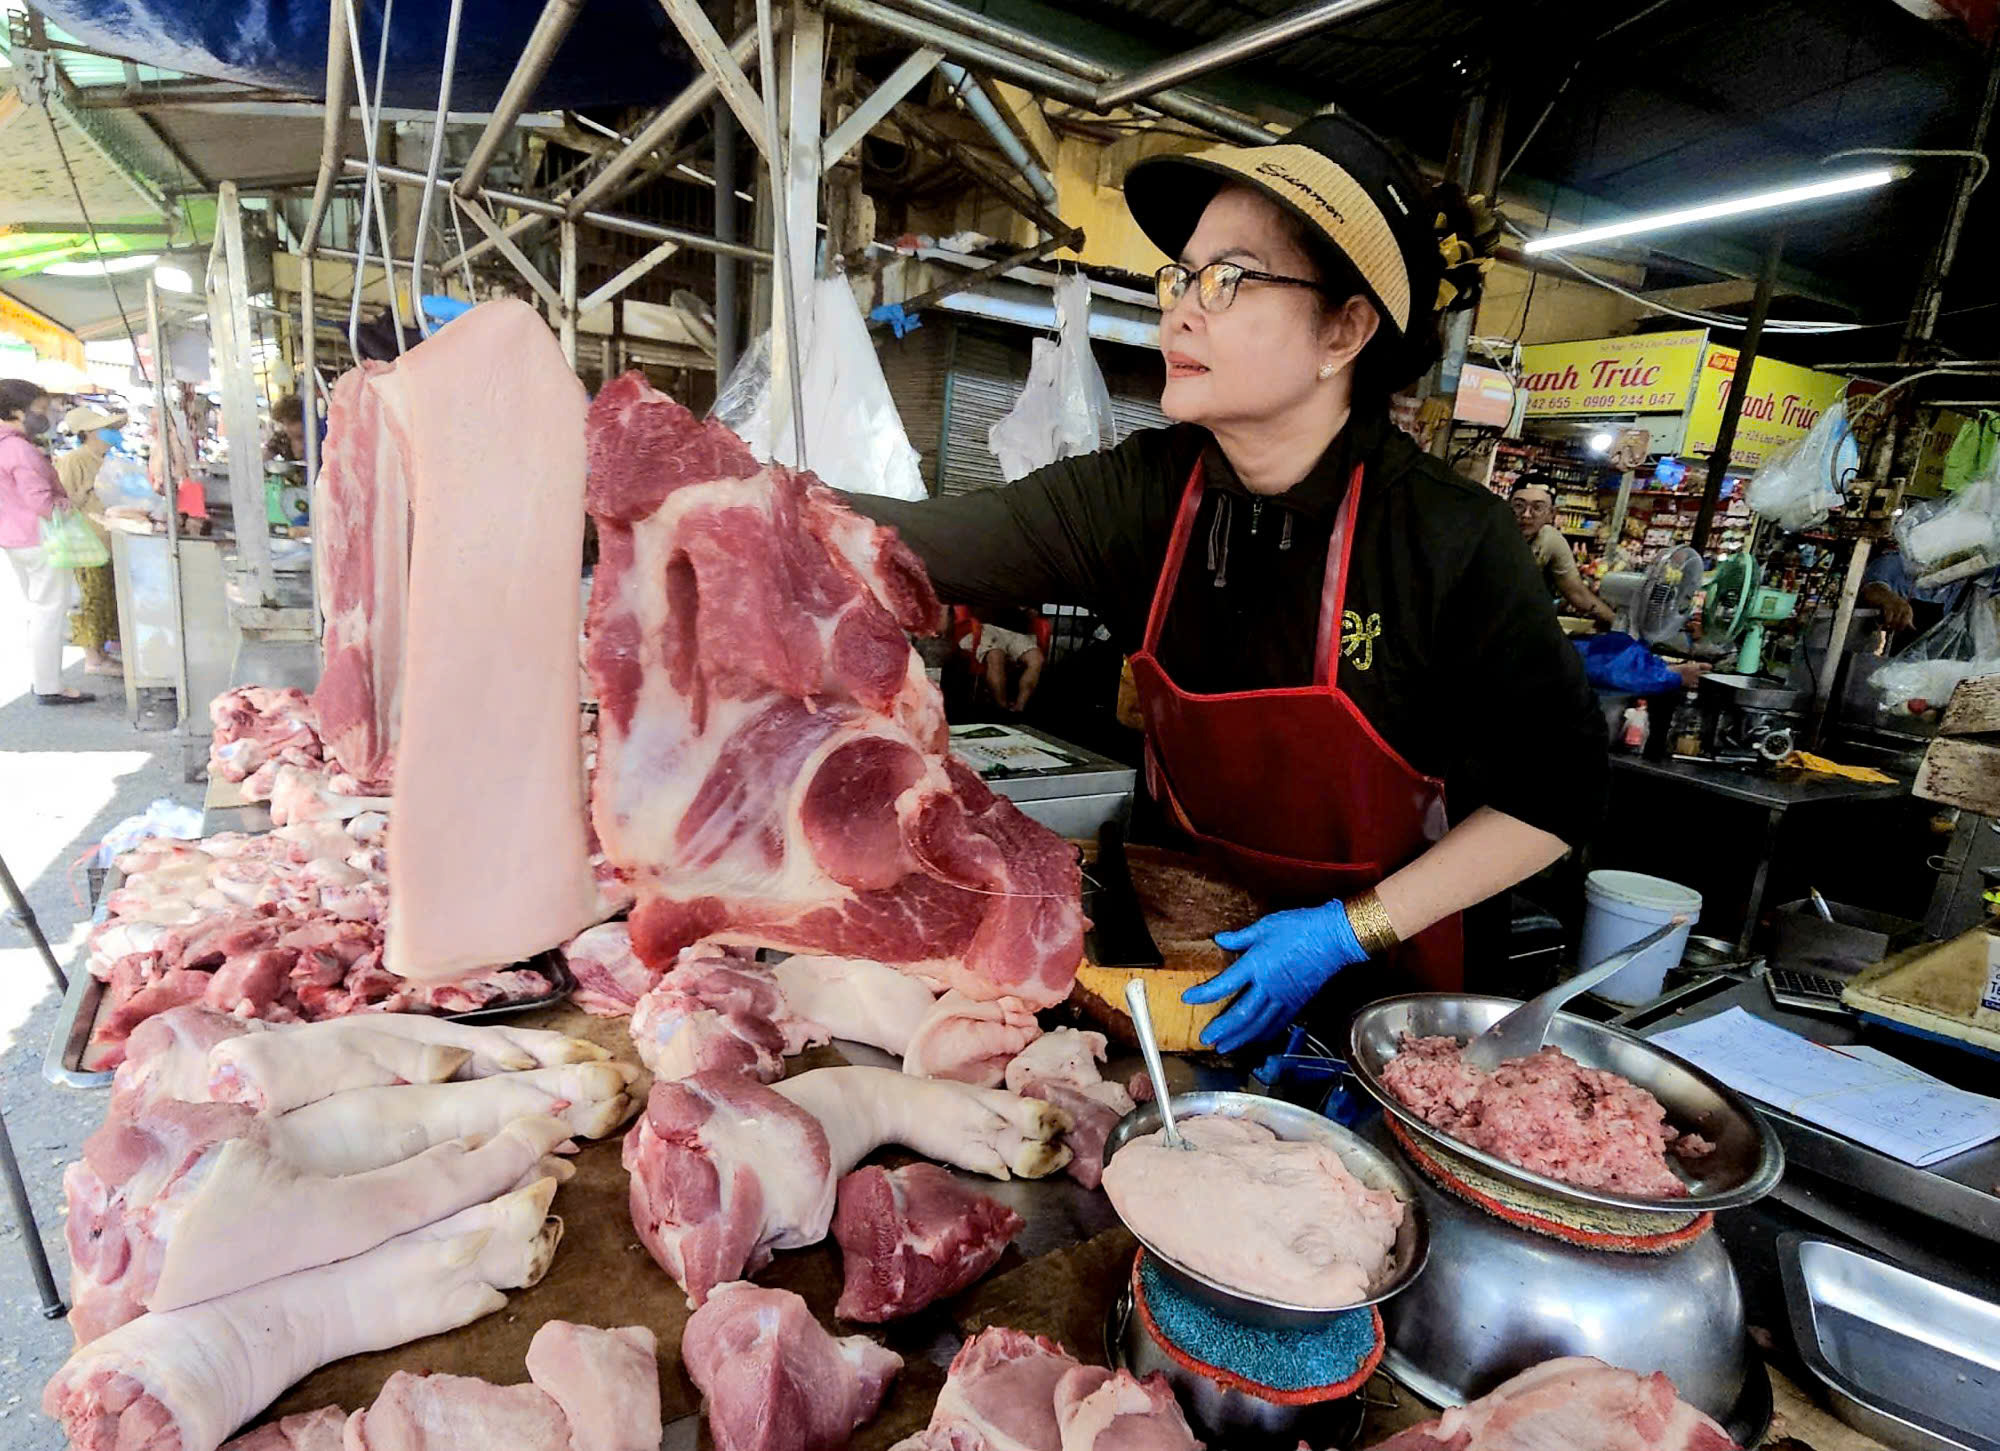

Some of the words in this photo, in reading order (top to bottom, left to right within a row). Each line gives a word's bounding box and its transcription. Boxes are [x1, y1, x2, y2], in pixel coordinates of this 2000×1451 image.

[1517, 364, 1579, 391] anh
[1591, 356, 1661, 389] Trúc
[1583, 394, 1616, 408] 0909
[1618, 393, 1644, 407] 244
[1648, 391, 1676, 406] 047
[1717, 379, 1776, 422] Tanh
[1782, 394, 1820, 430] Trúc
